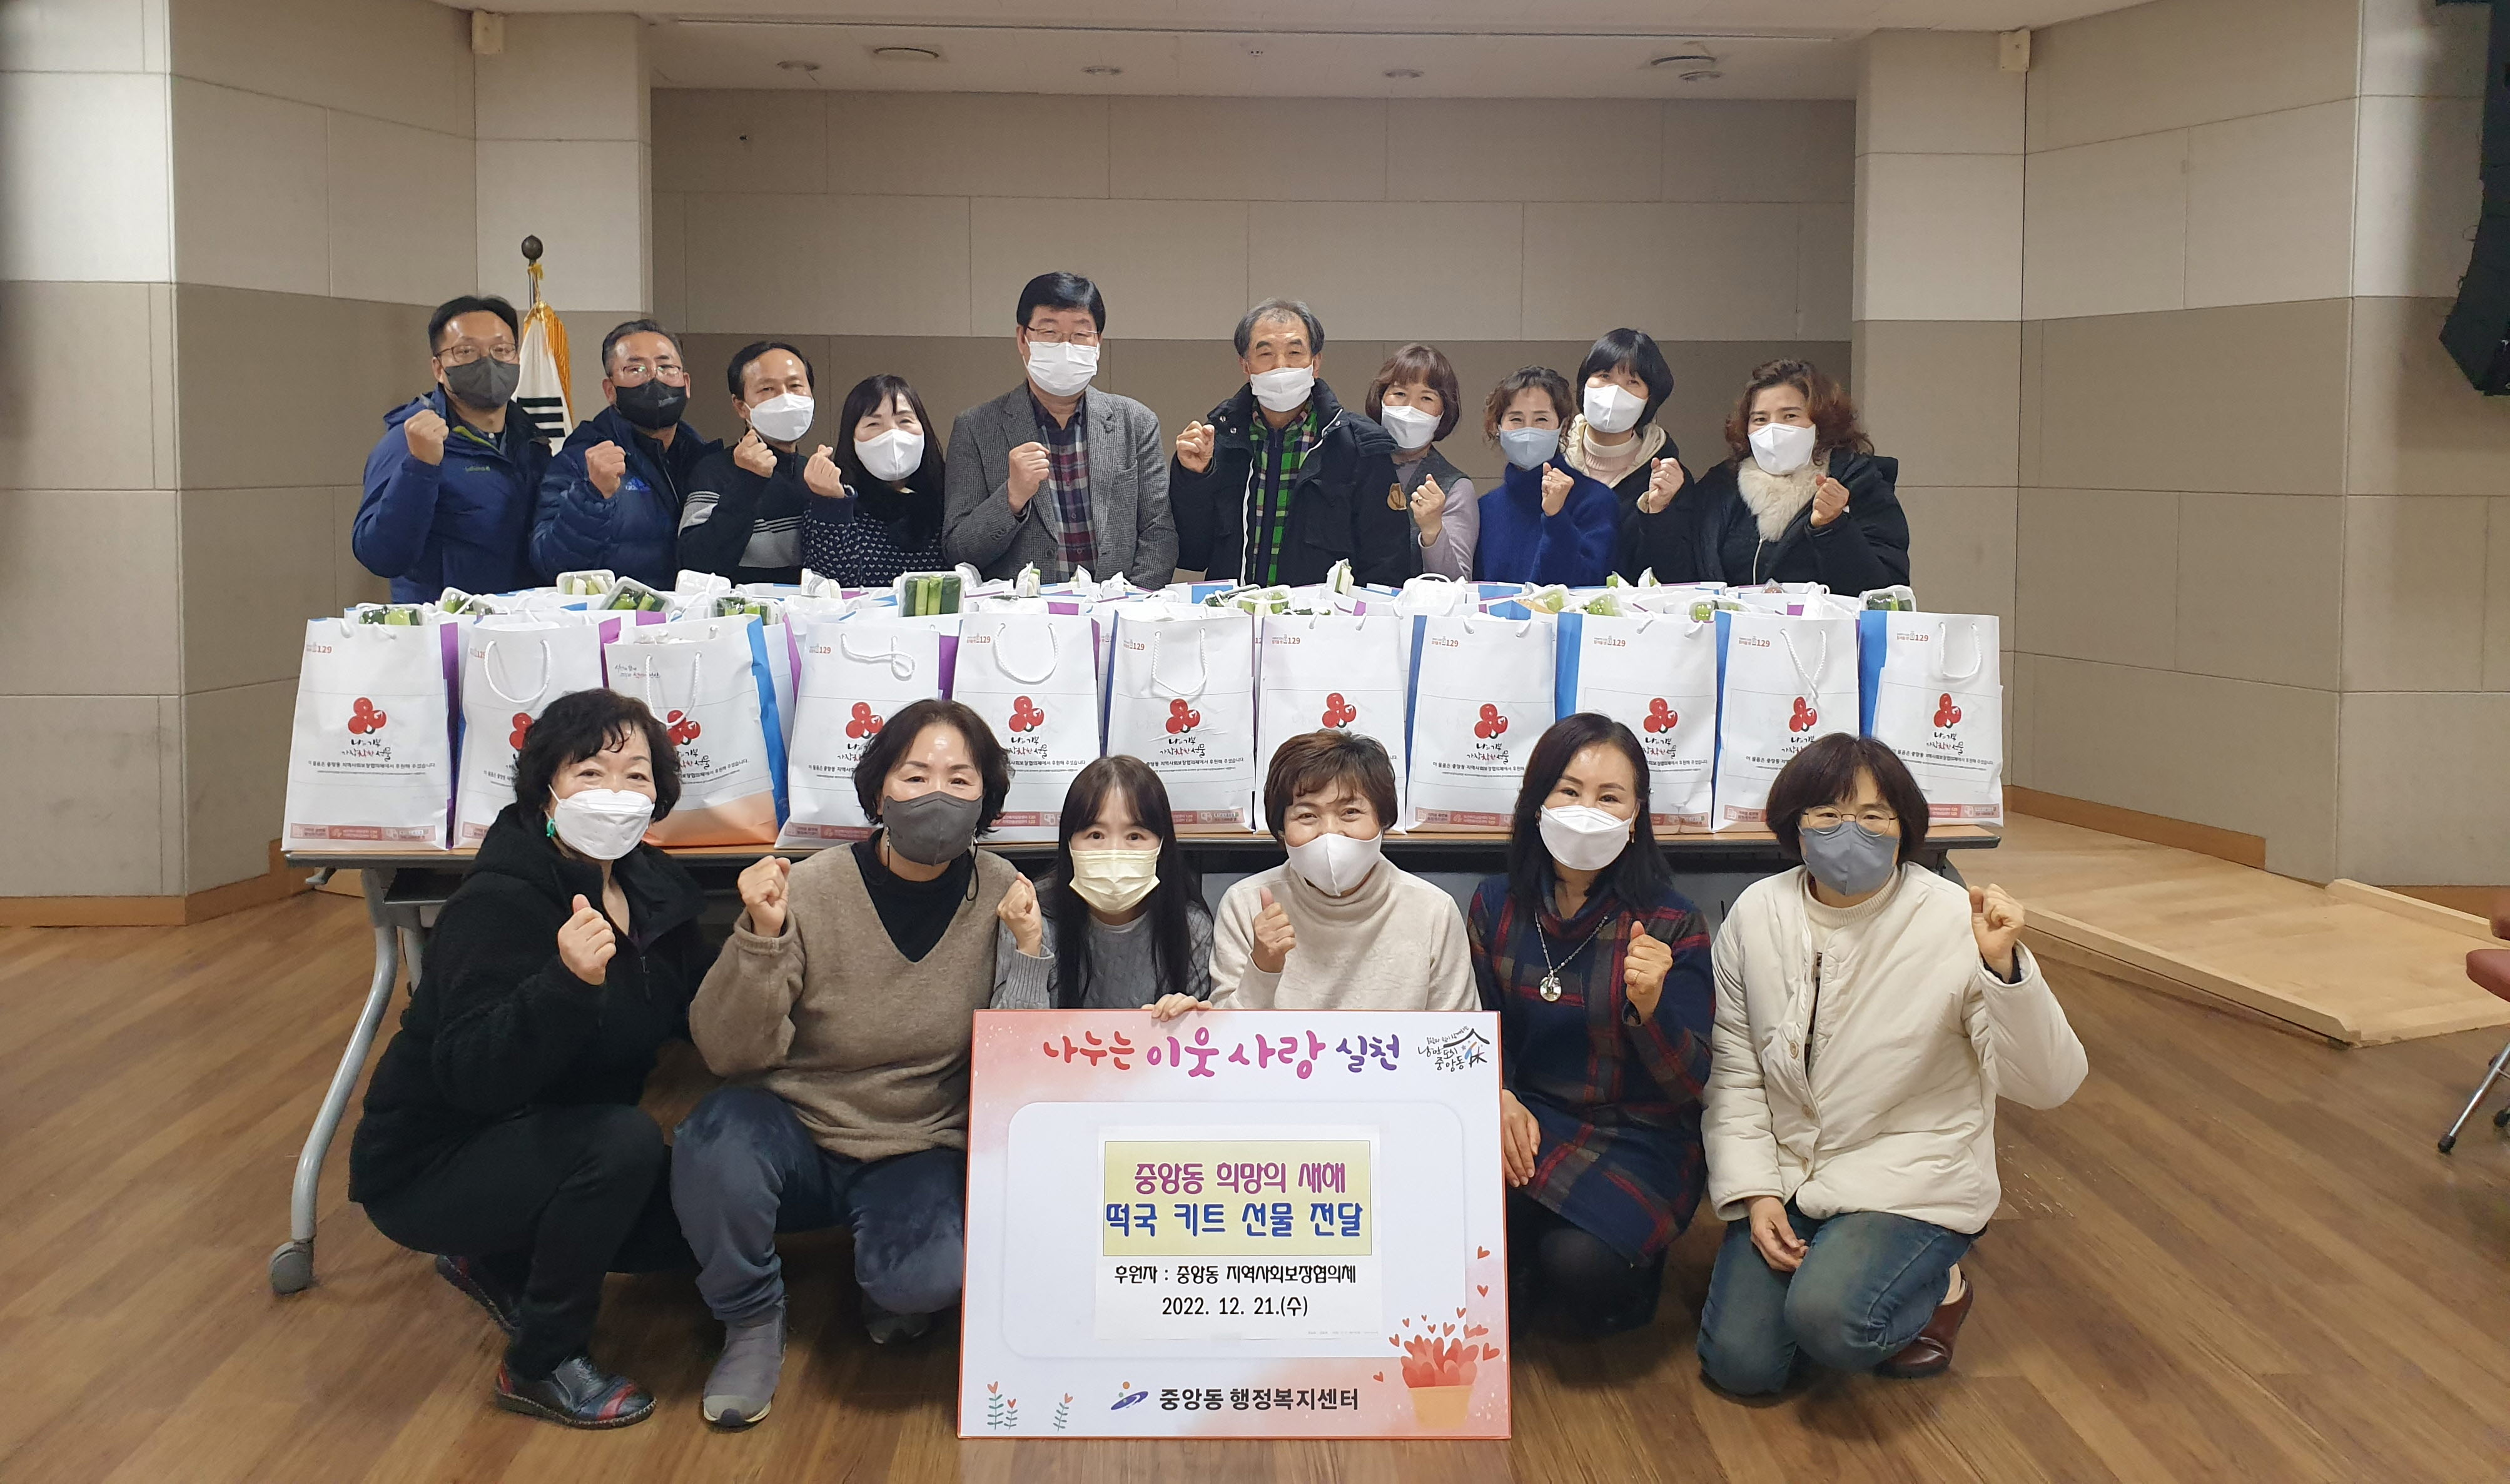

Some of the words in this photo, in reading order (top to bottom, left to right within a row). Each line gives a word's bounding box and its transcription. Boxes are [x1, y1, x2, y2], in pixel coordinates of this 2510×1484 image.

[317, 645, 331, 654] 129
[1133, 642, 1145, 650] 129
[1034, 744, 1048, 759] 선물
[1191, 744, 1205, 758] 선물
[1043, 1031, 1135, 1070] 나누는
[1147, 1027, 1219, 1077] 이웃
[1228, 1030, 1326, 1079] 사랑
[1336, 1034, 1399, 1073] 실천
[1434, 1056, 1465, 1072] 중앙동
[1134, 1163, 1204, 1195] 중앙동
[1217, 1163, 1287, 1194] 희망의
[1297, 1162, 1346, 1193] 새해
[1106, 1203, 1157, 1238] 떡국
[1173, 1203, 1225, 1238] 키트
[1241, 1201, 1293, 1238] 선물
[1309, 1202, 1363, 1238] 전달
[1115, 1266, 1158, 1284] 후원자
[1177, 1266, 1219, 1284] 중앙동
[1227, 1265, 1355, 1284] 지역사회보장협의체
[1162, 1297, 1208, 1315] 2022.
[1220, 1297, 1244, 1315] 12.
[1254, 1296, 1307, 1316] 21.(수)
[1160, 1388, 1223, 1410] 중앙동
[1230, 1388, 1357, 1410] 행정복지센터
